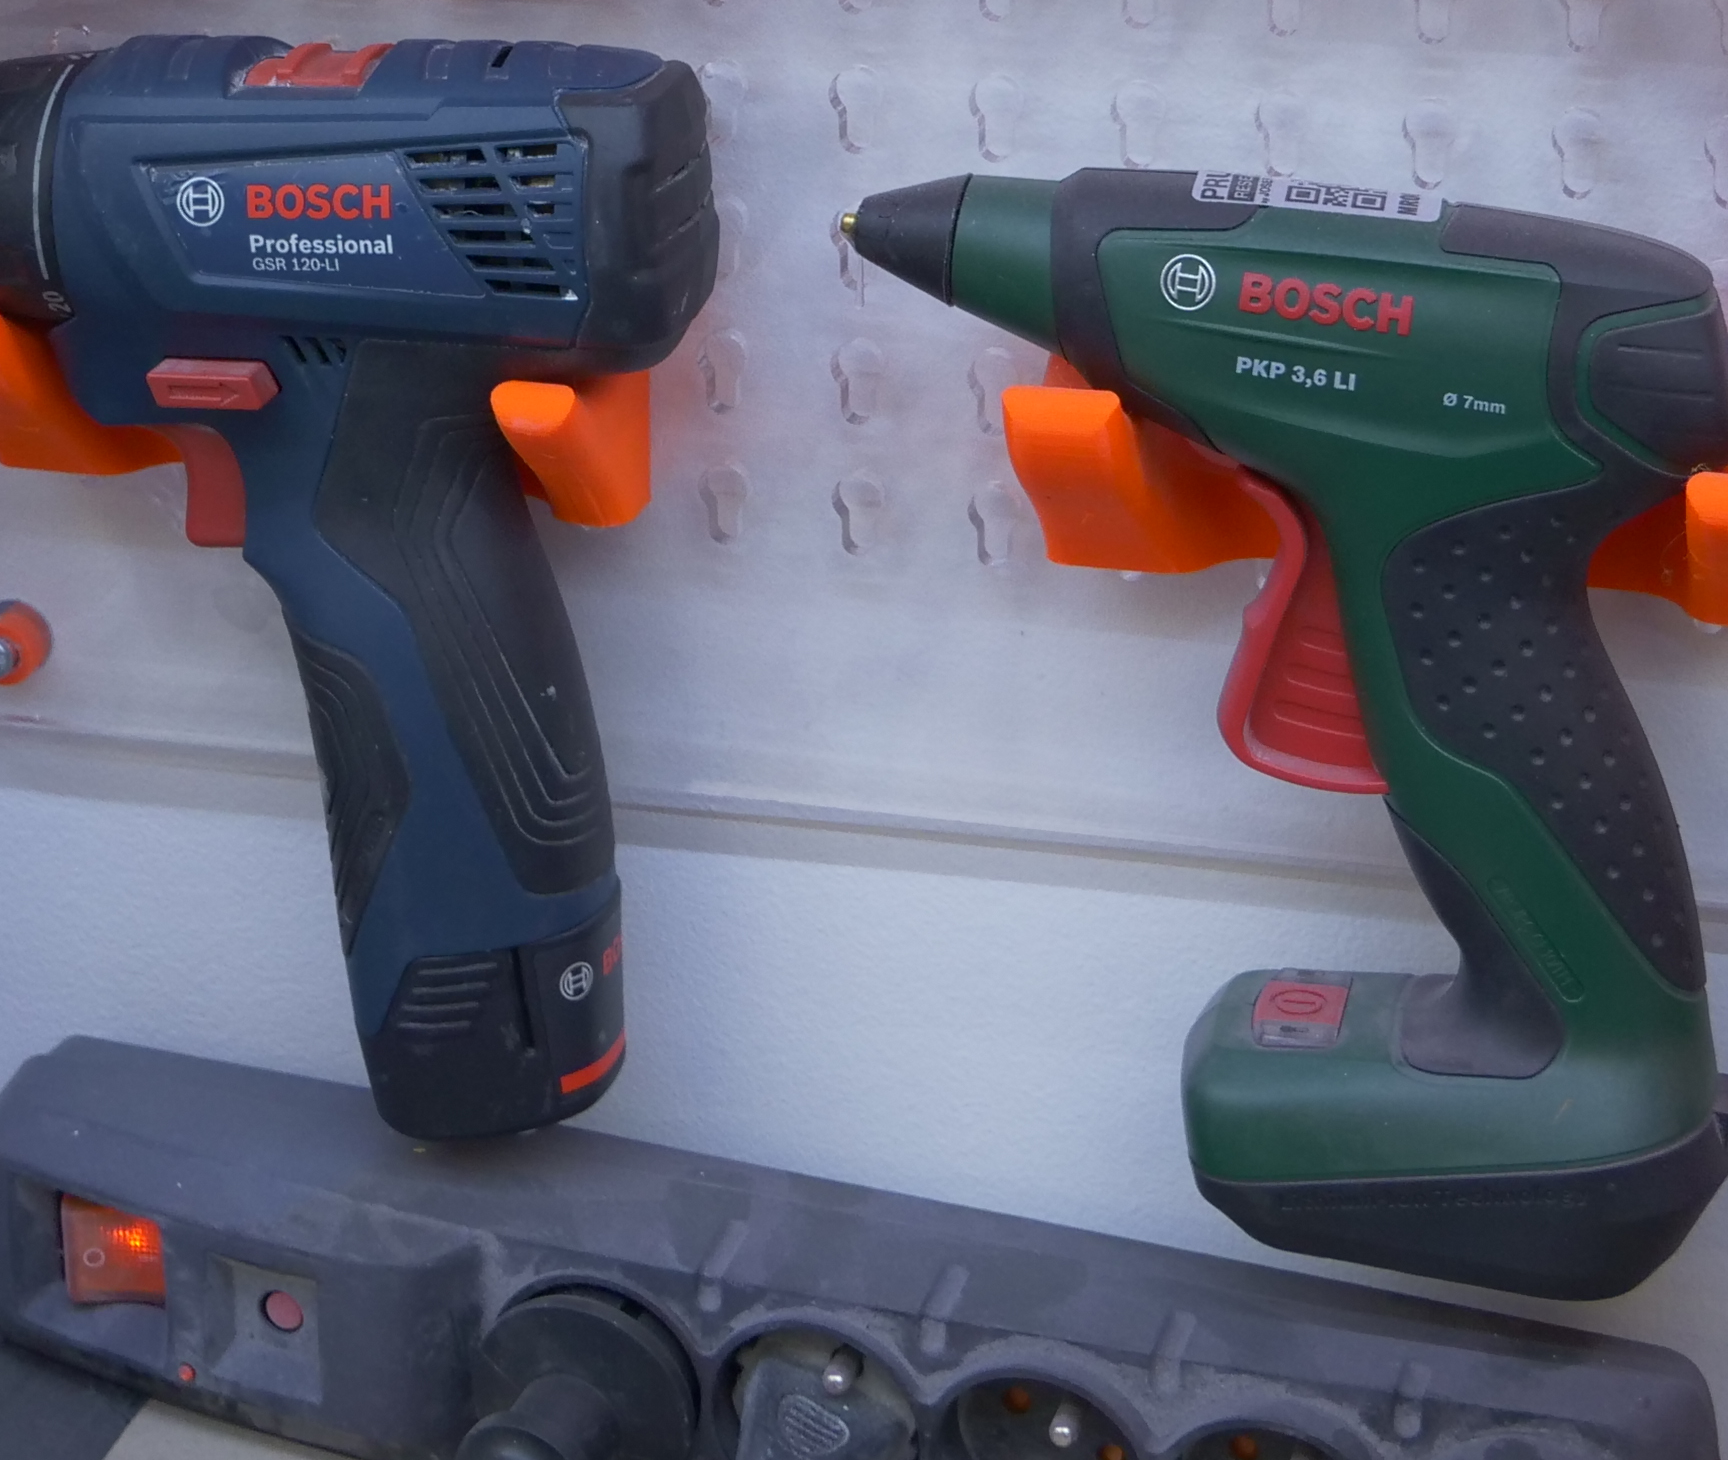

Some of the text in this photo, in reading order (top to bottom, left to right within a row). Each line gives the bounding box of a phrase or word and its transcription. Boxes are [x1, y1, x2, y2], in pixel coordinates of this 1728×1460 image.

[246, 183, 393, 221] BOSCH
[249, 234, 394, 256] Professional
[252, 258, 340, 273] GSR 120-LI
[1238, 271, 1415, 336] BOSCH
[1235, 355, 1357, 392] PKP 3,6 LI
[1463, 395, 1507, 416] 7mm
